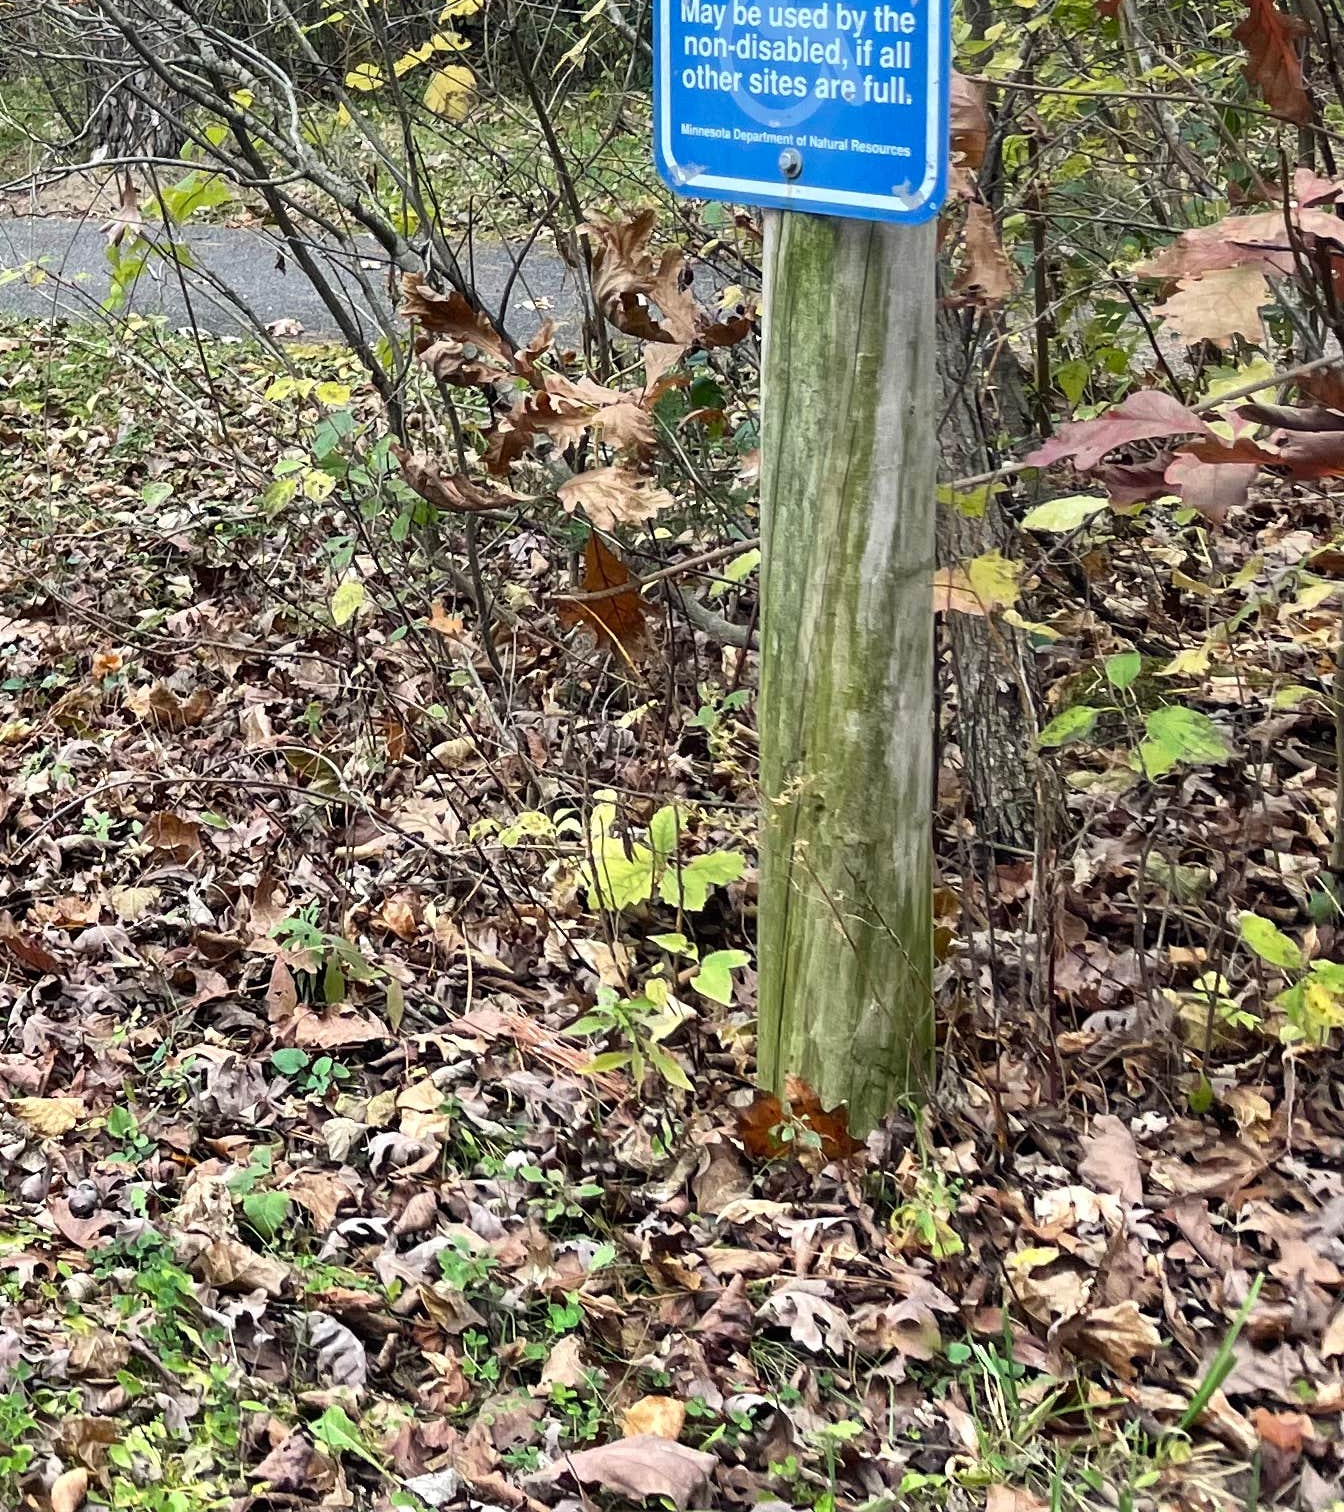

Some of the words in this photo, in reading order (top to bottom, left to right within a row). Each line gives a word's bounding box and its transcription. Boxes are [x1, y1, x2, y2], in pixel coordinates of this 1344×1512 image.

[769, 2, 827, 30] used
[836, 4, 867, 37] by
[874, 6, 915, 34] the
[684, 33, 848, 70] non-disabled,
[856, 38, 876, 67] if
[879, 41, 911, 69] all
[682, 65, 743, 91] other
[749, 67, 807, 97] sites
[815, 77, 857, 101] are
[863, 75, 912, 105] full.
[681, 123, 731, 140] Minnesota
[733, 128, 794, 146] Department
[796, 133, 807, 146] of
[809, 135, 848, 150] Natural
[851, 139, 911, 157] Resources
